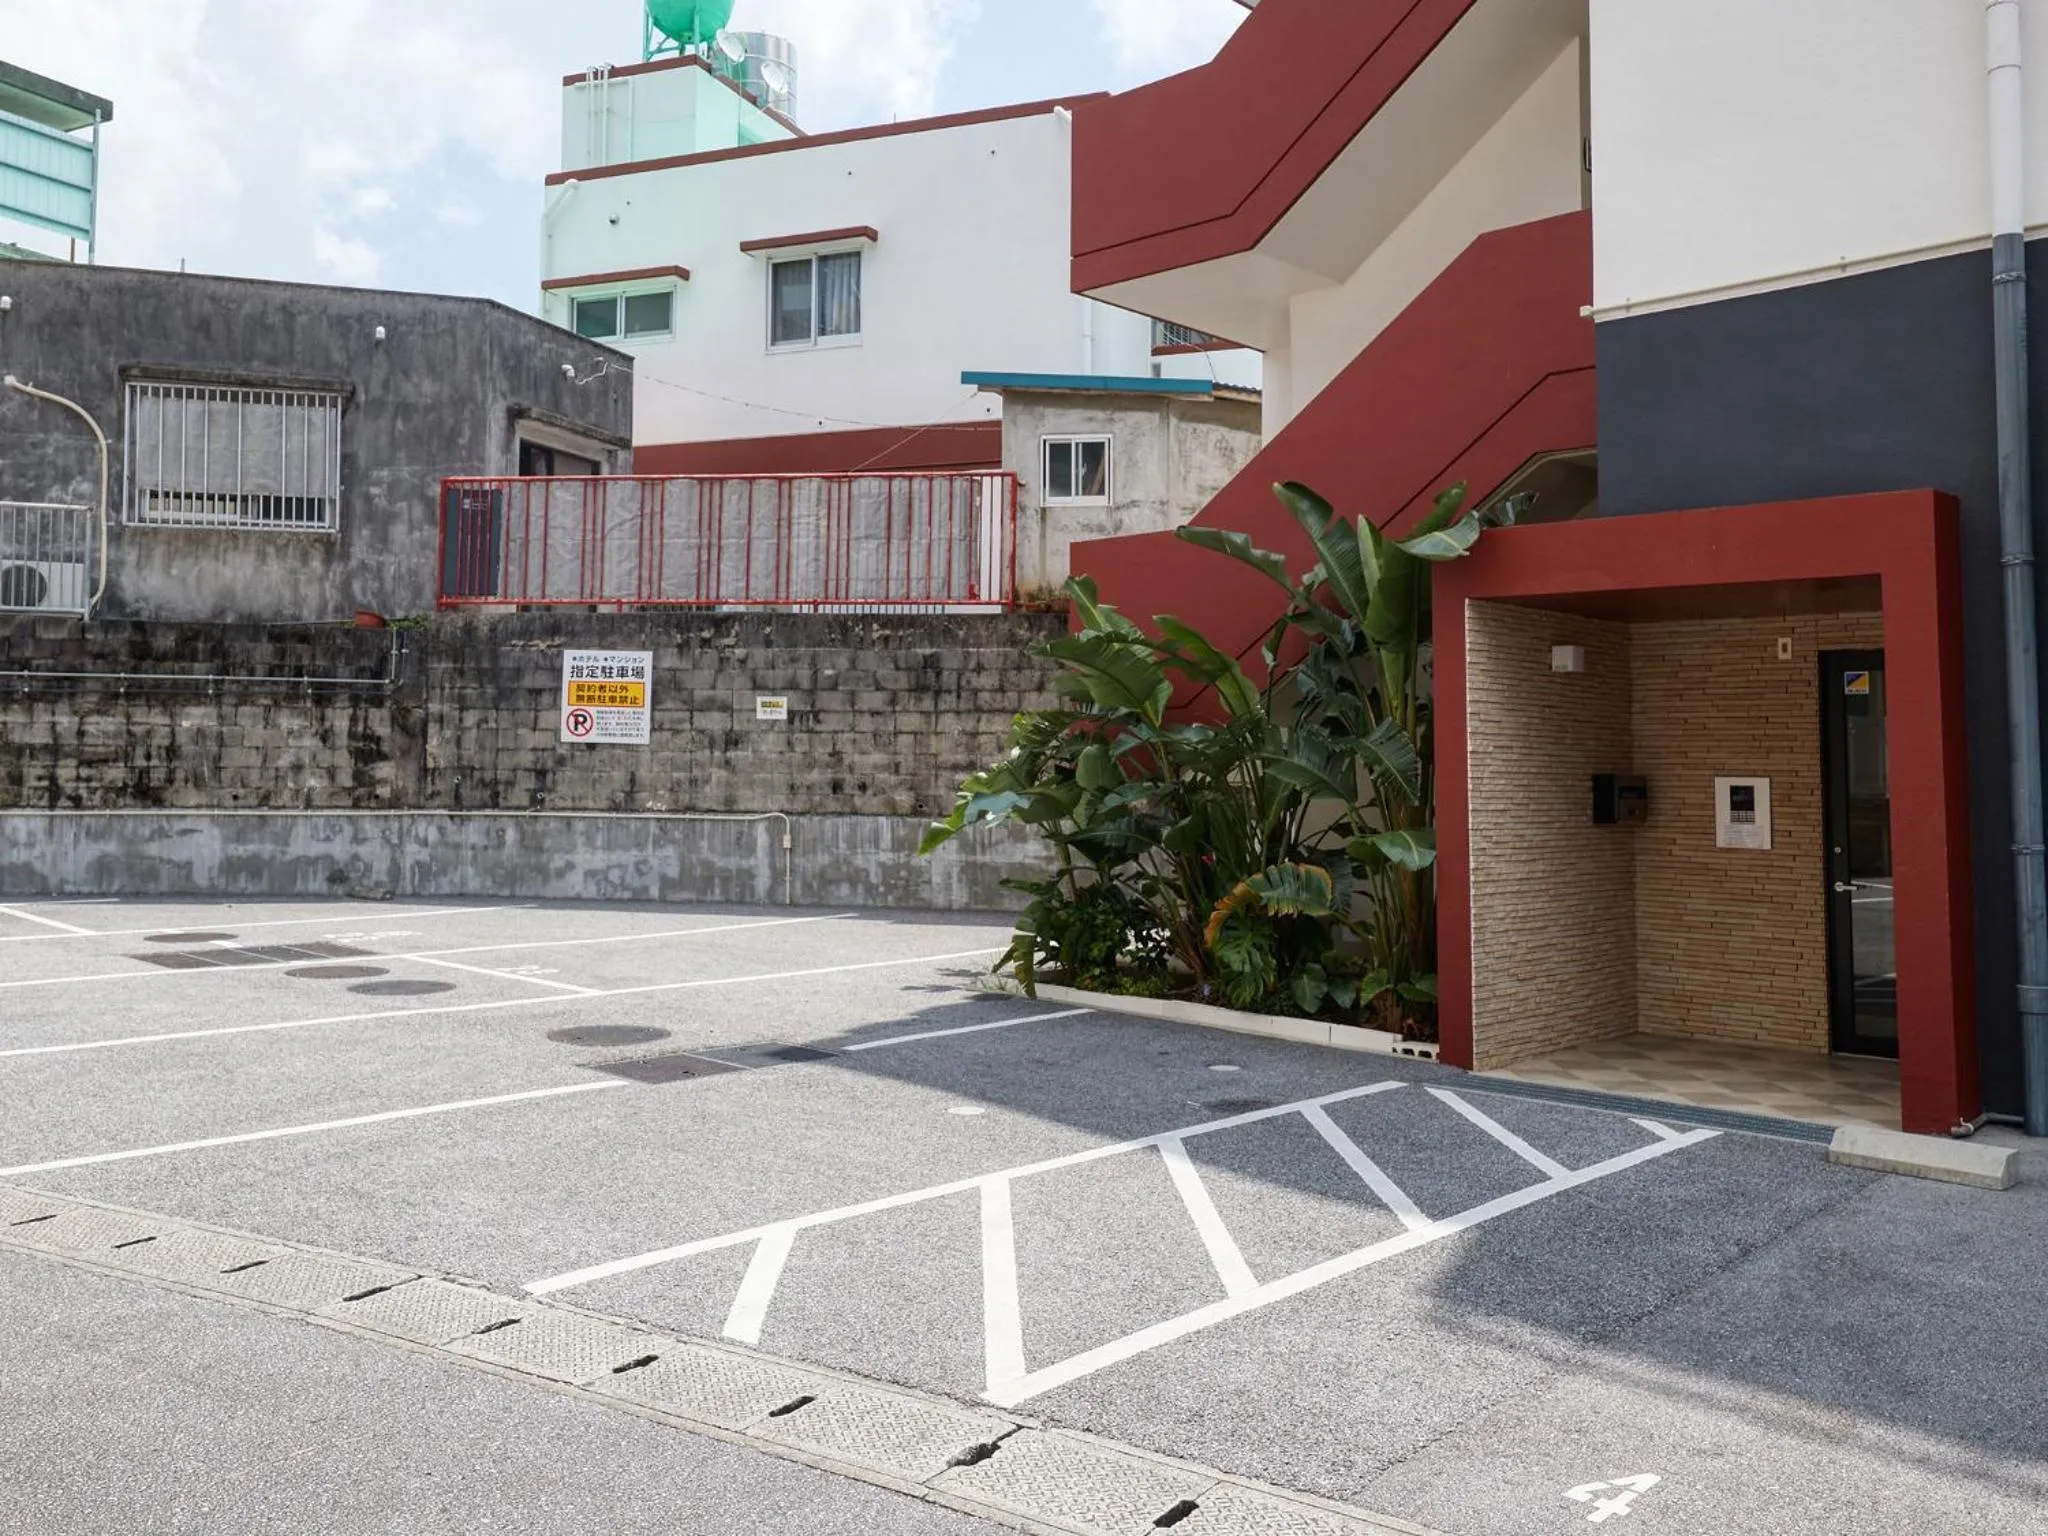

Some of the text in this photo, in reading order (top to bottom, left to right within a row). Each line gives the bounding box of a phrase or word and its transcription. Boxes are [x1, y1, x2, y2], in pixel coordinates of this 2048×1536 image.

[570, 664, 645, 679] 指定駐車場
[576, 683, 628, 694] 契約者以外
[575, 695, 639, 705] 無断駐車禁止
[573, 713, 587, 731] P
[1562, 1472, 1662, 1523] 4
